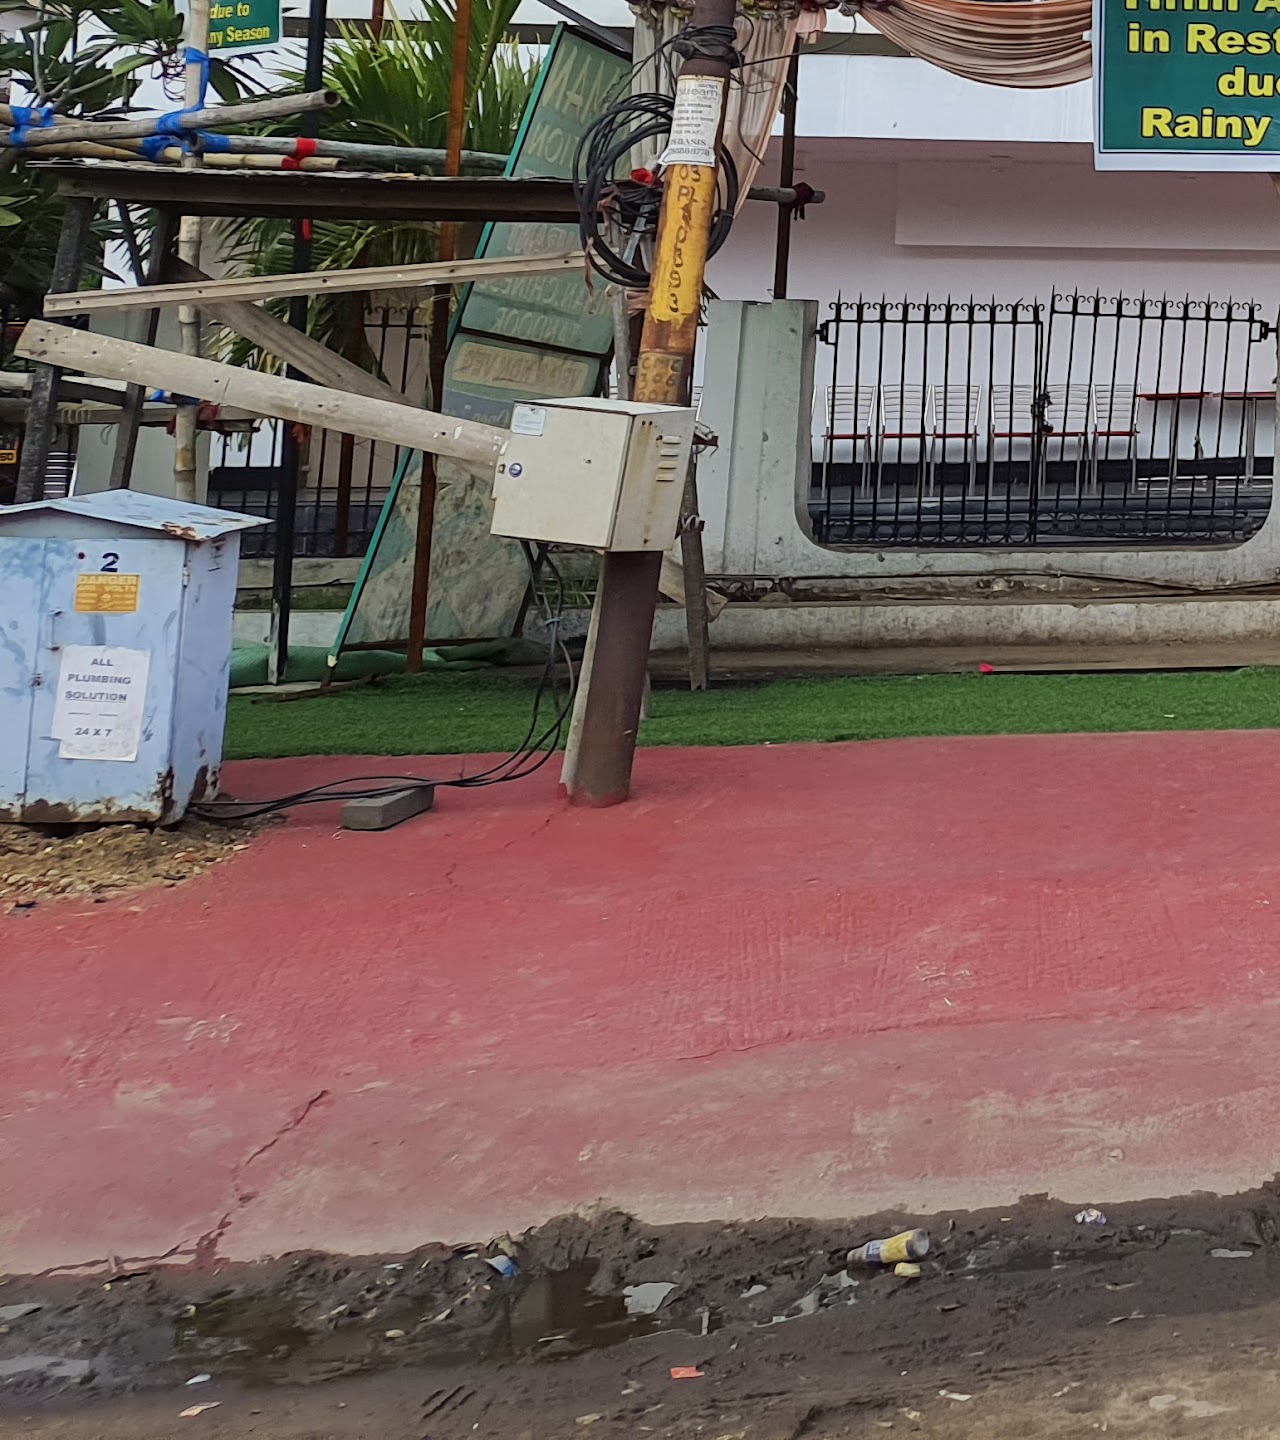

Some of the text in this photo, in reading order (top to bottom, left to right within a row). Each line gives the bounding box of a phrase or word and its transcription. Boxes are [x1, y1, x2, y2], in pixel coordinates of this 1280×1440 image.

[210, 2, 250, 19] due to
[227, 26, 270, 42] Season
[1127, 23, 1170, 53] in
[1141, 107, 1271, 147] Rainy
[101, 552, 119, 572] 2
[79, 575, 136, 585] DANGER
[90, 658, 113, 666] ALL
[67, 674, 131, 684] PLUMBING
[65, 691, 127, 700] SOLUTION
[74, 727, 89, 735] 24
